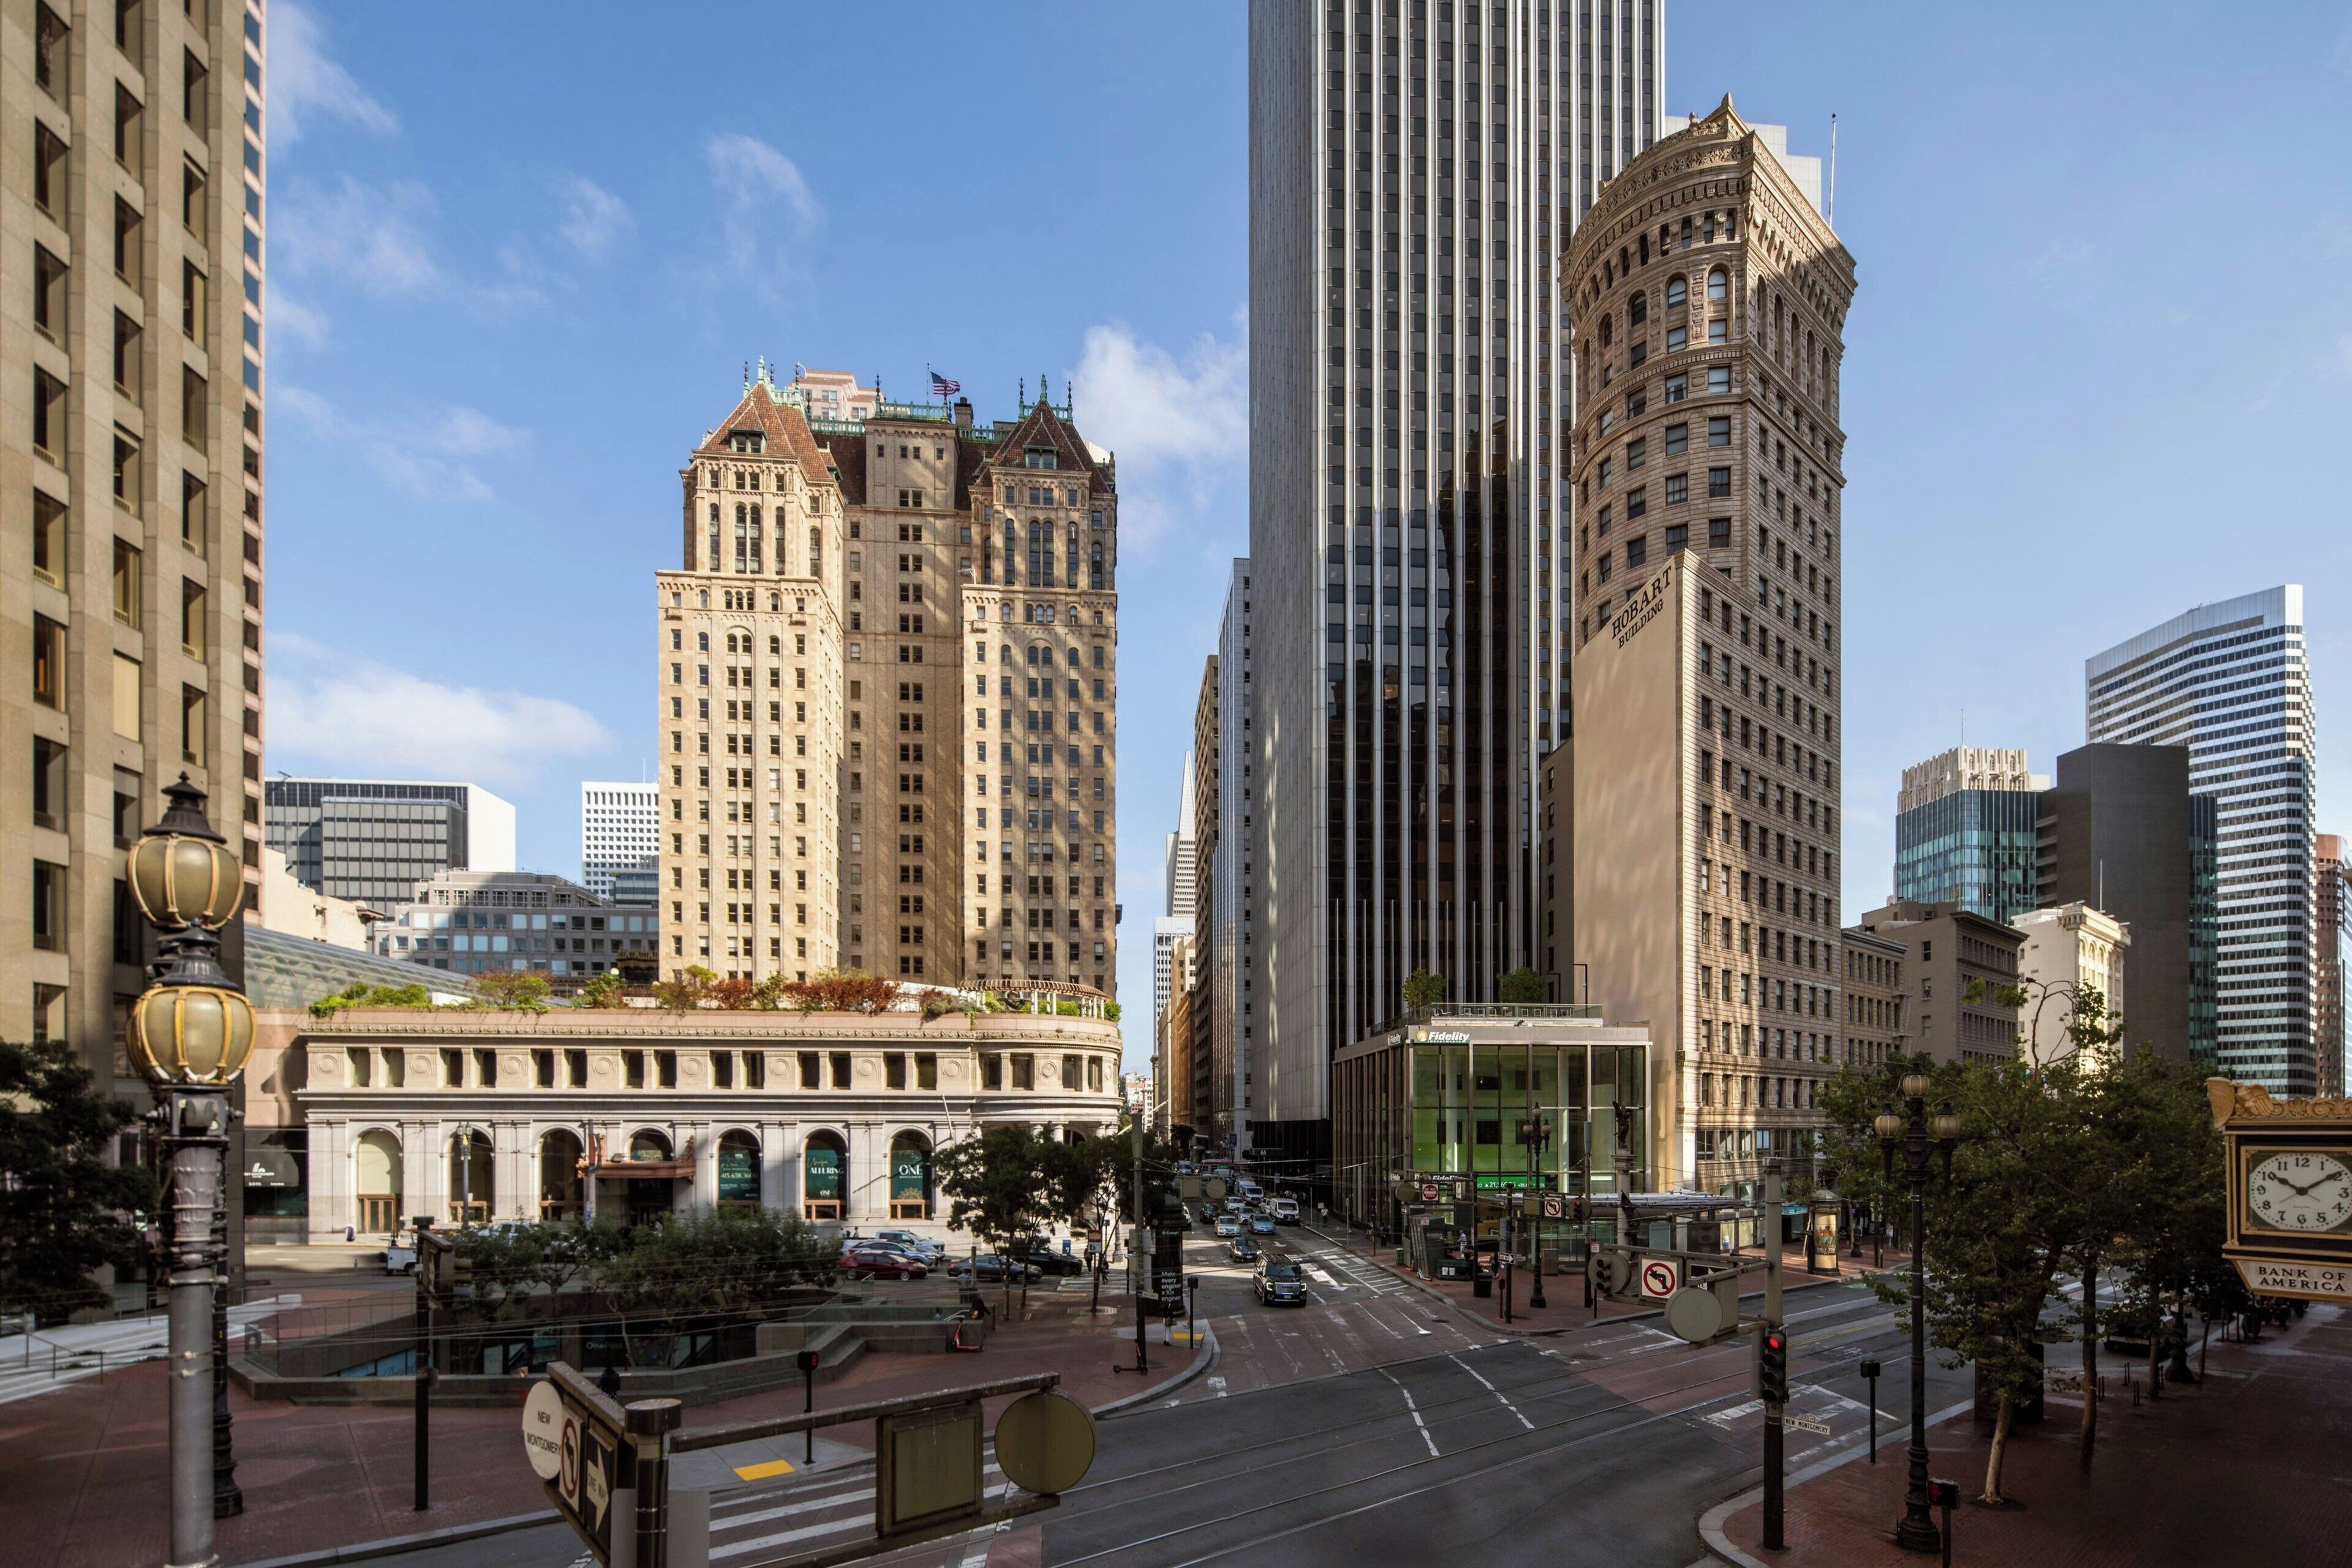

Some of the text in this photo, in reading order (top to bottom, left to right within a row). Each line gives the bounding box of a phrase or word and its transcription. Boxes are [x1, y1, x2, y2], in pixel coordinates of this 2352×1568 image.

[1611, 565, 1672, 639] HOBART
[1618, 598, 1664, 649] BUILDING
[1428, 1031, 1469, 1042] Fidelity
[2278, 1161, 2288, 1171] 11
[2295, 1157, 2310, 1167] 12
[899, 1164, 923, 1175] ONE
[2262, 1171, 2275, 1181] 10
[2256, 1185, 2266, 1195] 9
[2339, 1187, 2350, 1198] 3
[2262, 1200, 2271, 1210] 8
[2332, 1202, 2343, 1213] 4
[2278, 1210, 2286, 1221] 7
[2296, 1214, 2306, 1224] 6
[2316, 1212, 2327, 1223] 5
[2258, 1266, 2345, 1281] BANK OF
[2260, 1278, 2345, 1291] AMERICA
[538, 1411, 551, 1425] NEW
[1798, 1421, 1828, 1433] MONTGOMERY
[527, 1432, 561, 1456] MONTGOMERY
[588, 1472, 607, 1501] ONE WAY
